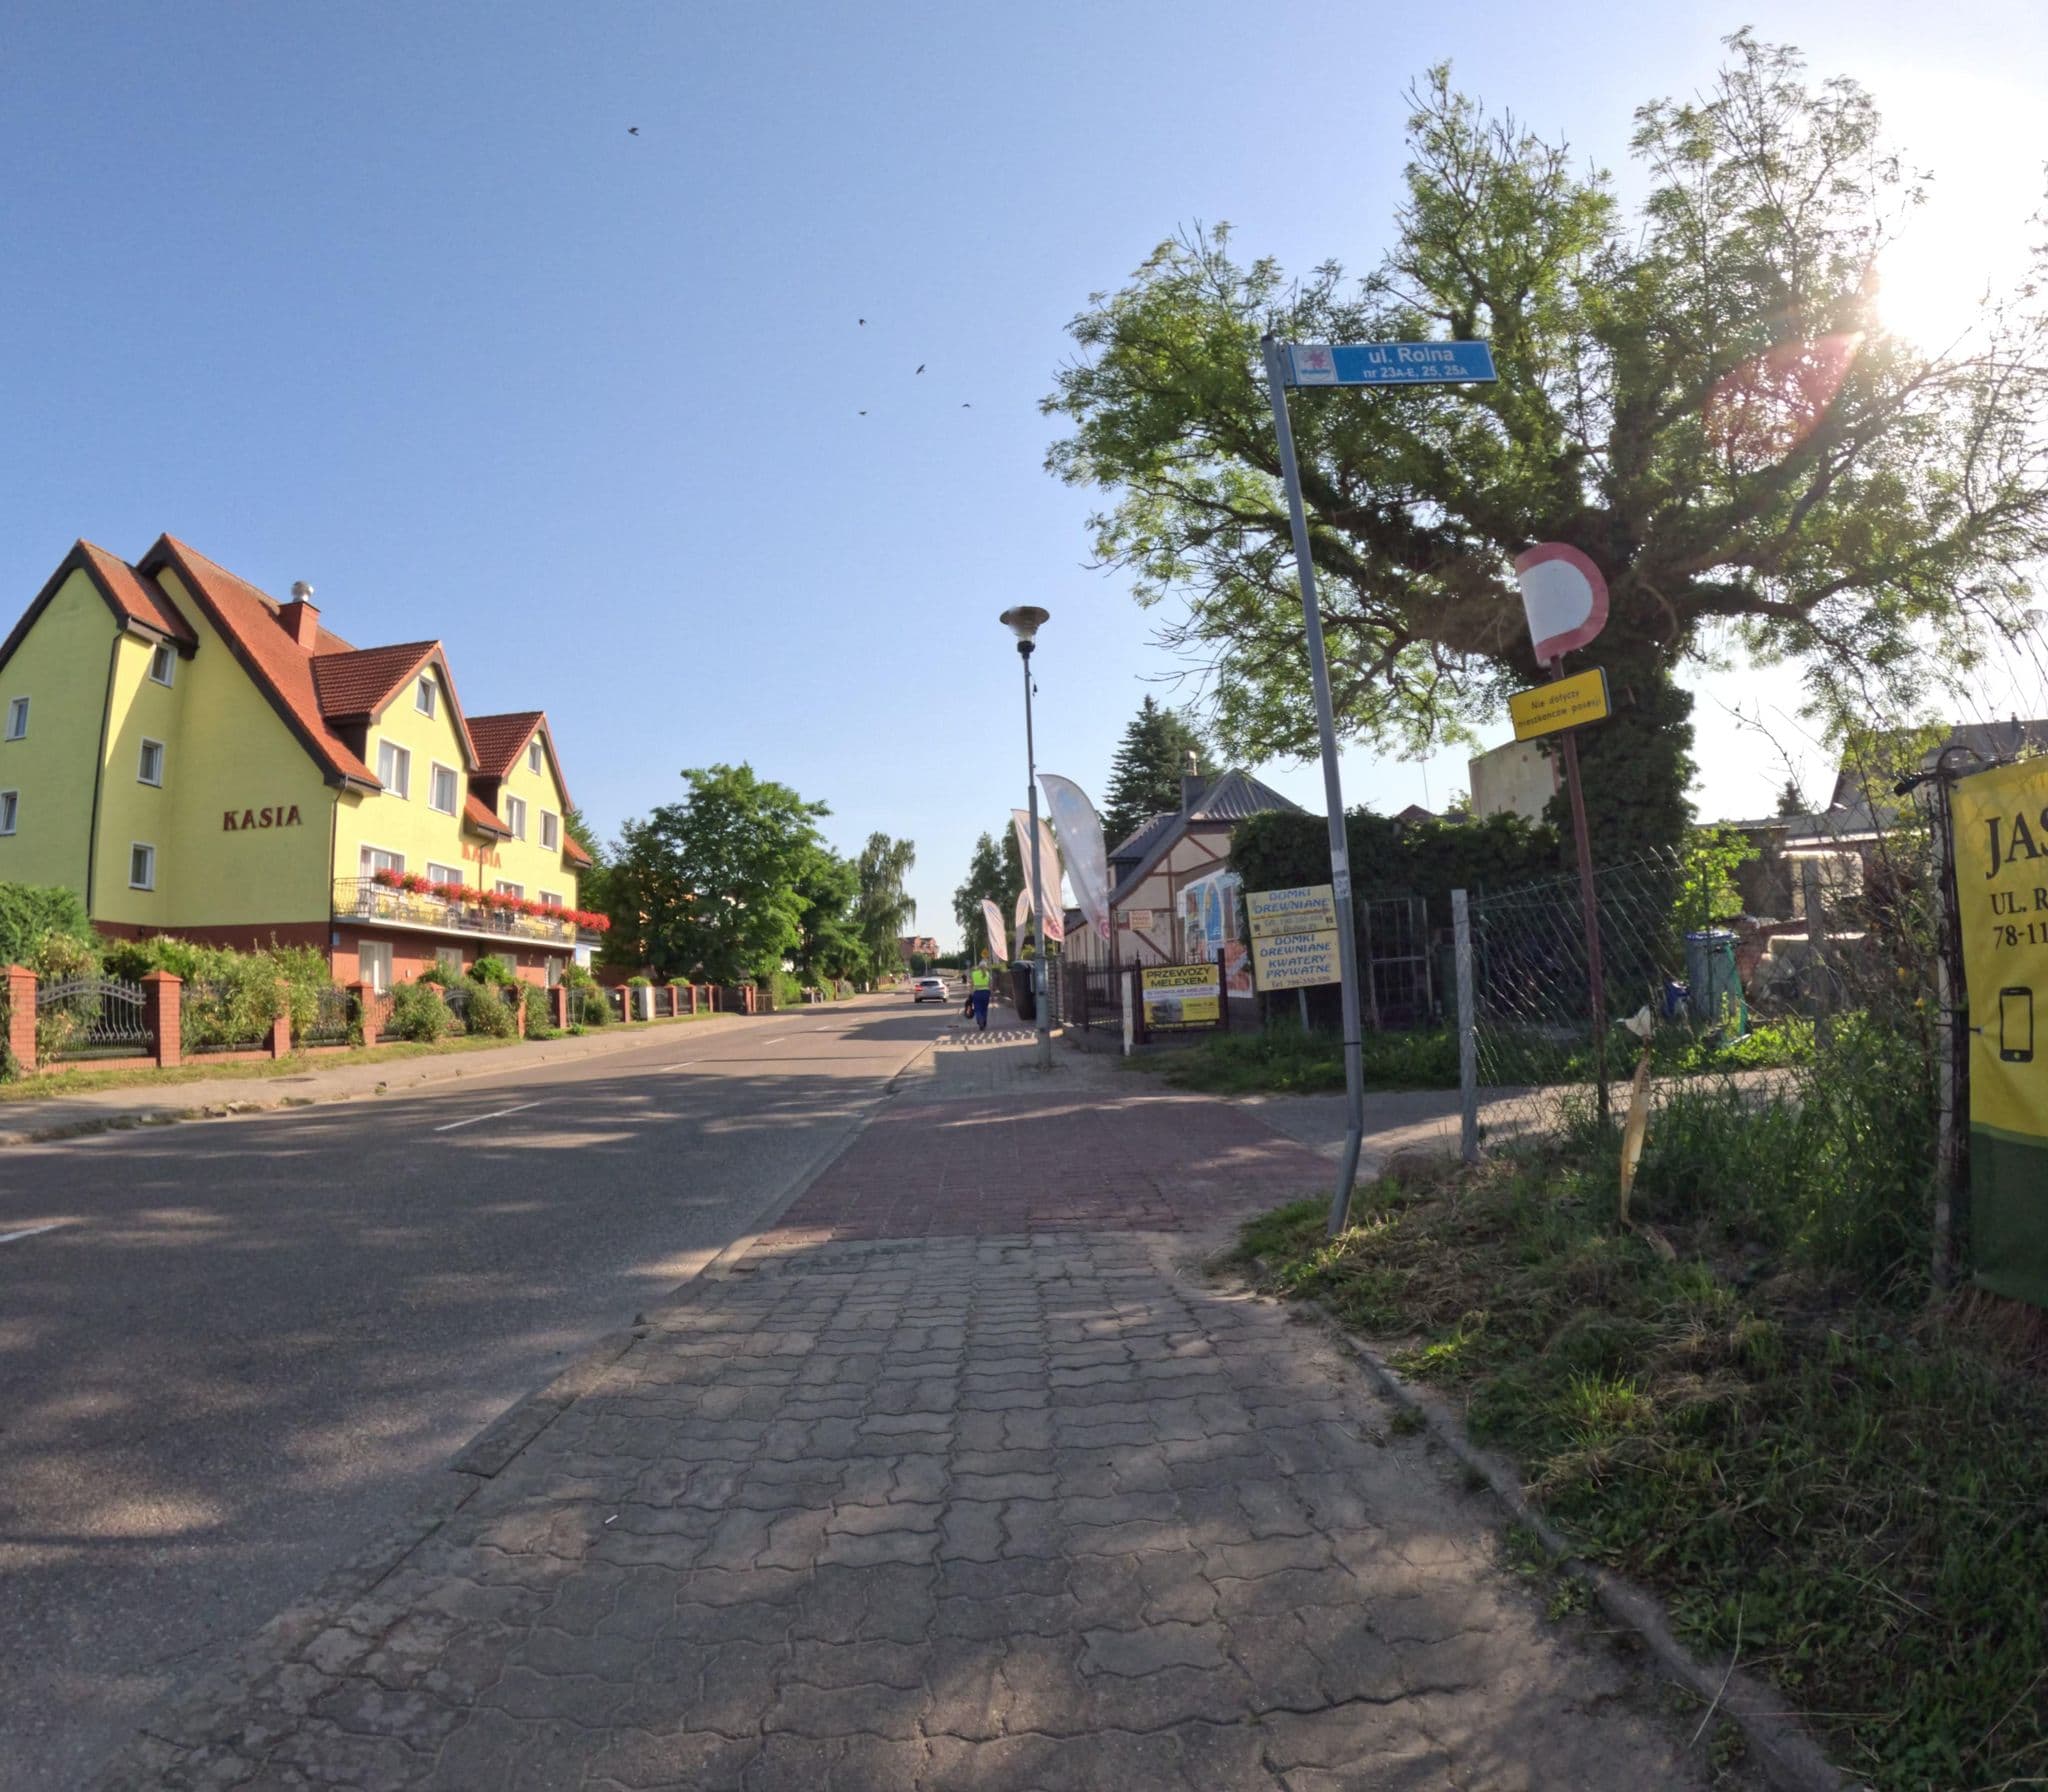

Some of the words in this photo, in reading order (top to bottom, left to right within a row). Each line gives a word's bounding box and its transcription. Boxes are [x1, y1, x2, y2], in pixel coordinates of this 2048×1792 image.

[1368, 347, 1393, 364] ul.
[1397, 346, 1455, 363] Rolna
[1363, 369, 1377, 378] nr
[1443, 364, 1469, 376] 25A
[1531, 700, 1544, 710] Nie
[1549, 691, 1579, 705] dotyczy
[223, 805, 304, 832] KASIA
[1269, 888, 1311, 901] DOMKI
[1254, 899, 1329, 914] DREWNIANE
[1990, 891, 2027, 916] UL.
[1274, 934, 1315, 946] DOMKI
[1260, 943, 1331, 958] DREWNIANE
[1269, 954, 1327, 969] KWATERY
[1146, 967, 1211, 979] PRZEWOZY
[1150, 976, 1208, 988] MELEXEM
